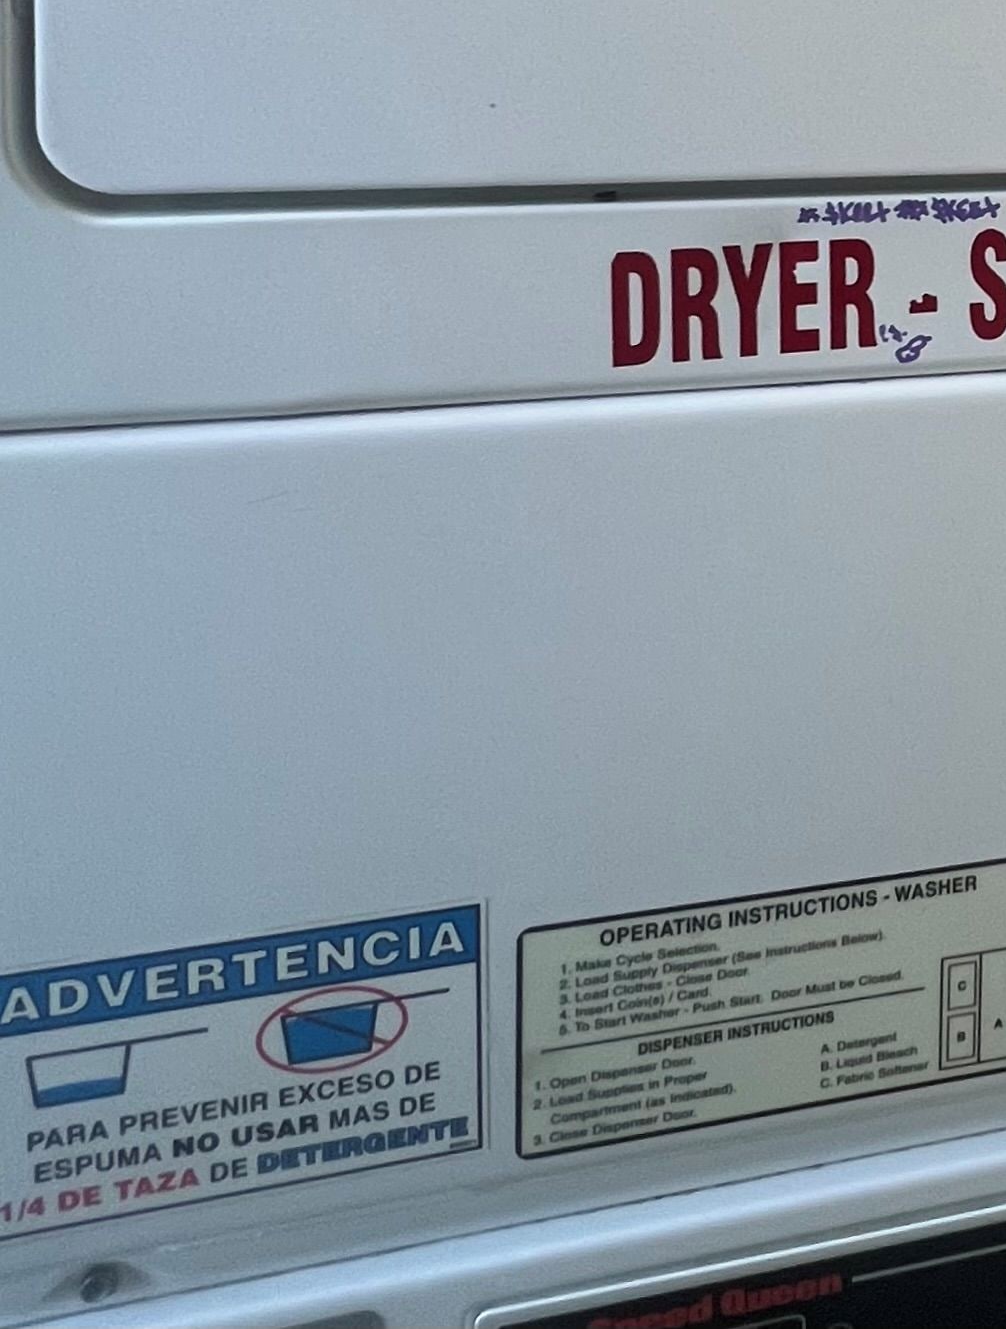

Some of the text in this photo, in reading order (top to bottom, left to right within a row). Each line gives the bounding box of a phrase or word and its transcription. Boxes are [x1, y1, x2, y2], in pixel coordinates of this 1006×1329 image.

[611, 238, 877, 367] DRYER
[600, 875, 977, 946] OPERATING INSTRUCTIONS WASHER
[1, 921, 465, 1024] ADVERTENCIA
[958, 981, 967, 991] C
[638, 1010, 835, 1056] DISPENSER INSTRUCTIONS
[957, 1032, 966, 1042] B
[994, 1018, 1003, 1029] A
[27, 1061, 440, 1151] PARA PREVENIR EXCESO DE
[34, 1093, 435, 1183] ESPUMA NO USAR MAS DE
[0, 1116, 468, 1222] 1/4 DE TAZA DE DETERGENTE
[720, 1273, 842, 1316] Queen
